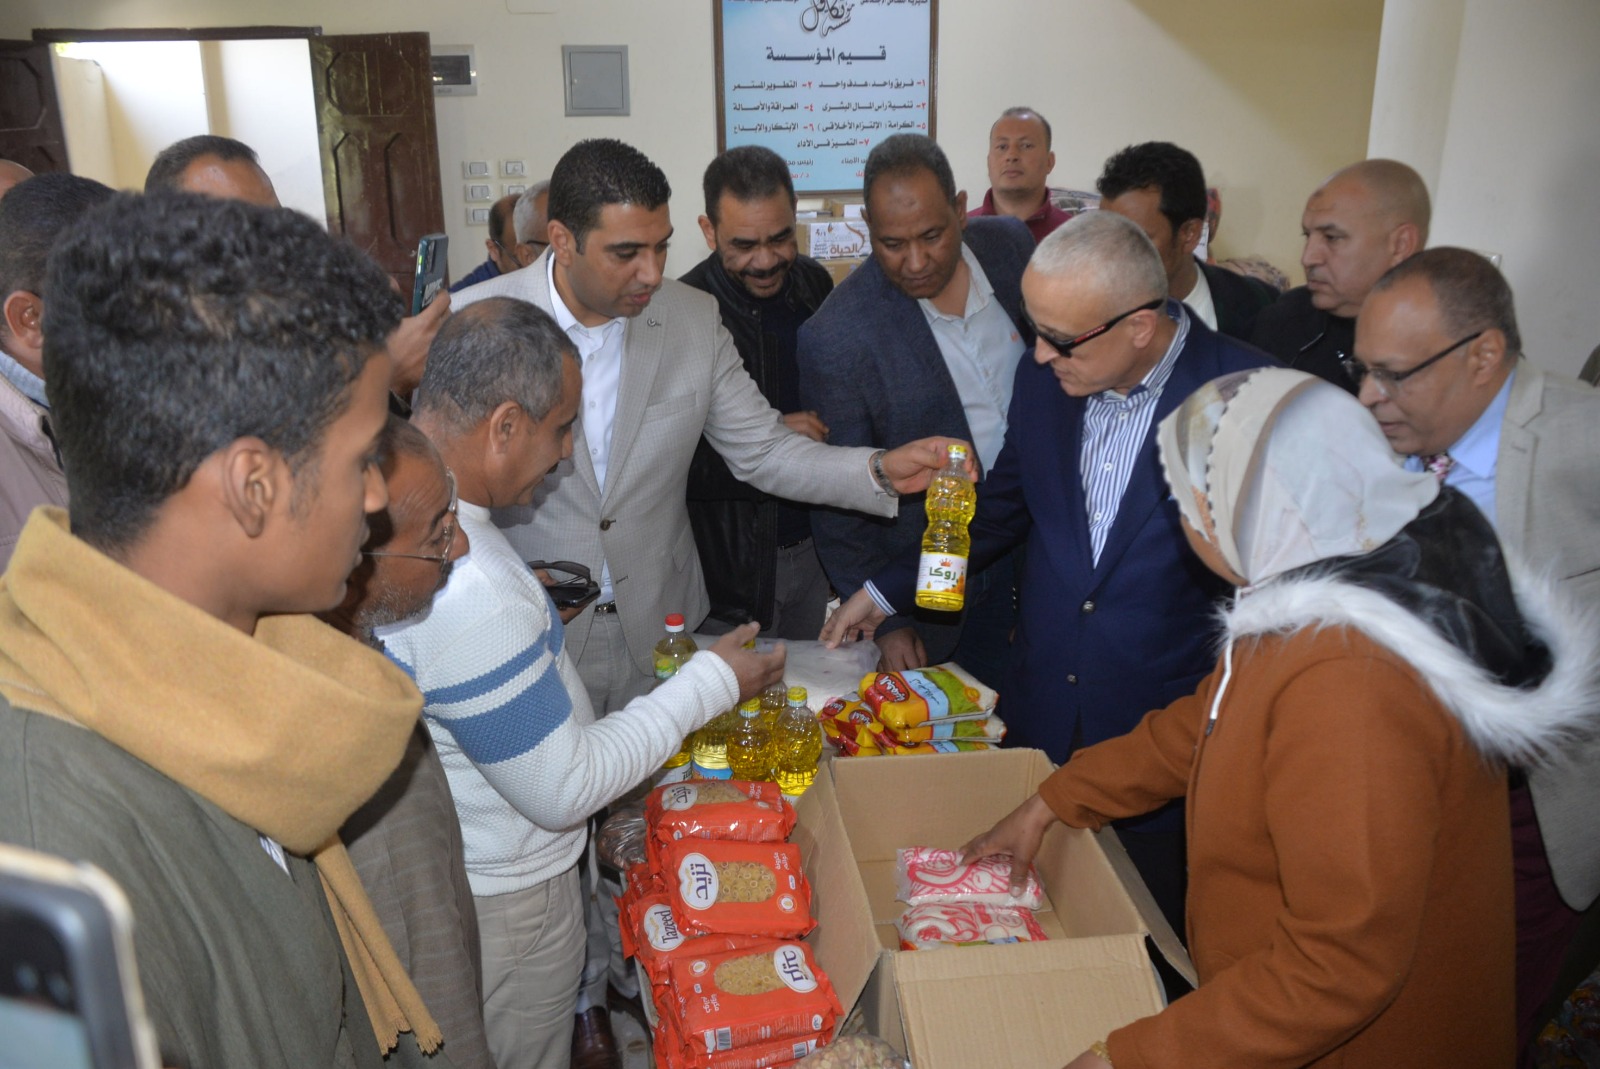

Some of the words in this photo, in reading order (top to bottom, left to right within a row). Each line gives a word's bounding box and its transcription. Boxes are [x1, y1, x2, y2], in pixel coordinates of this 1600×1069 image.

[766, 46, 835, 66] المؤسسة
[837, 45, 886, 66] قيم
[818, 79, 846, 89] واحد
[893, 79, 914, 90] فريق
[771, 102, 799, 112] العراقة
[888, 100, 913, 111] تنمية
[888, 120, 915, 131] الكرامة
[929, 566, 956, 581] روكا
[690, 863, 713, 900] تزيد
[654, 909, 679, 944] Tazeed
